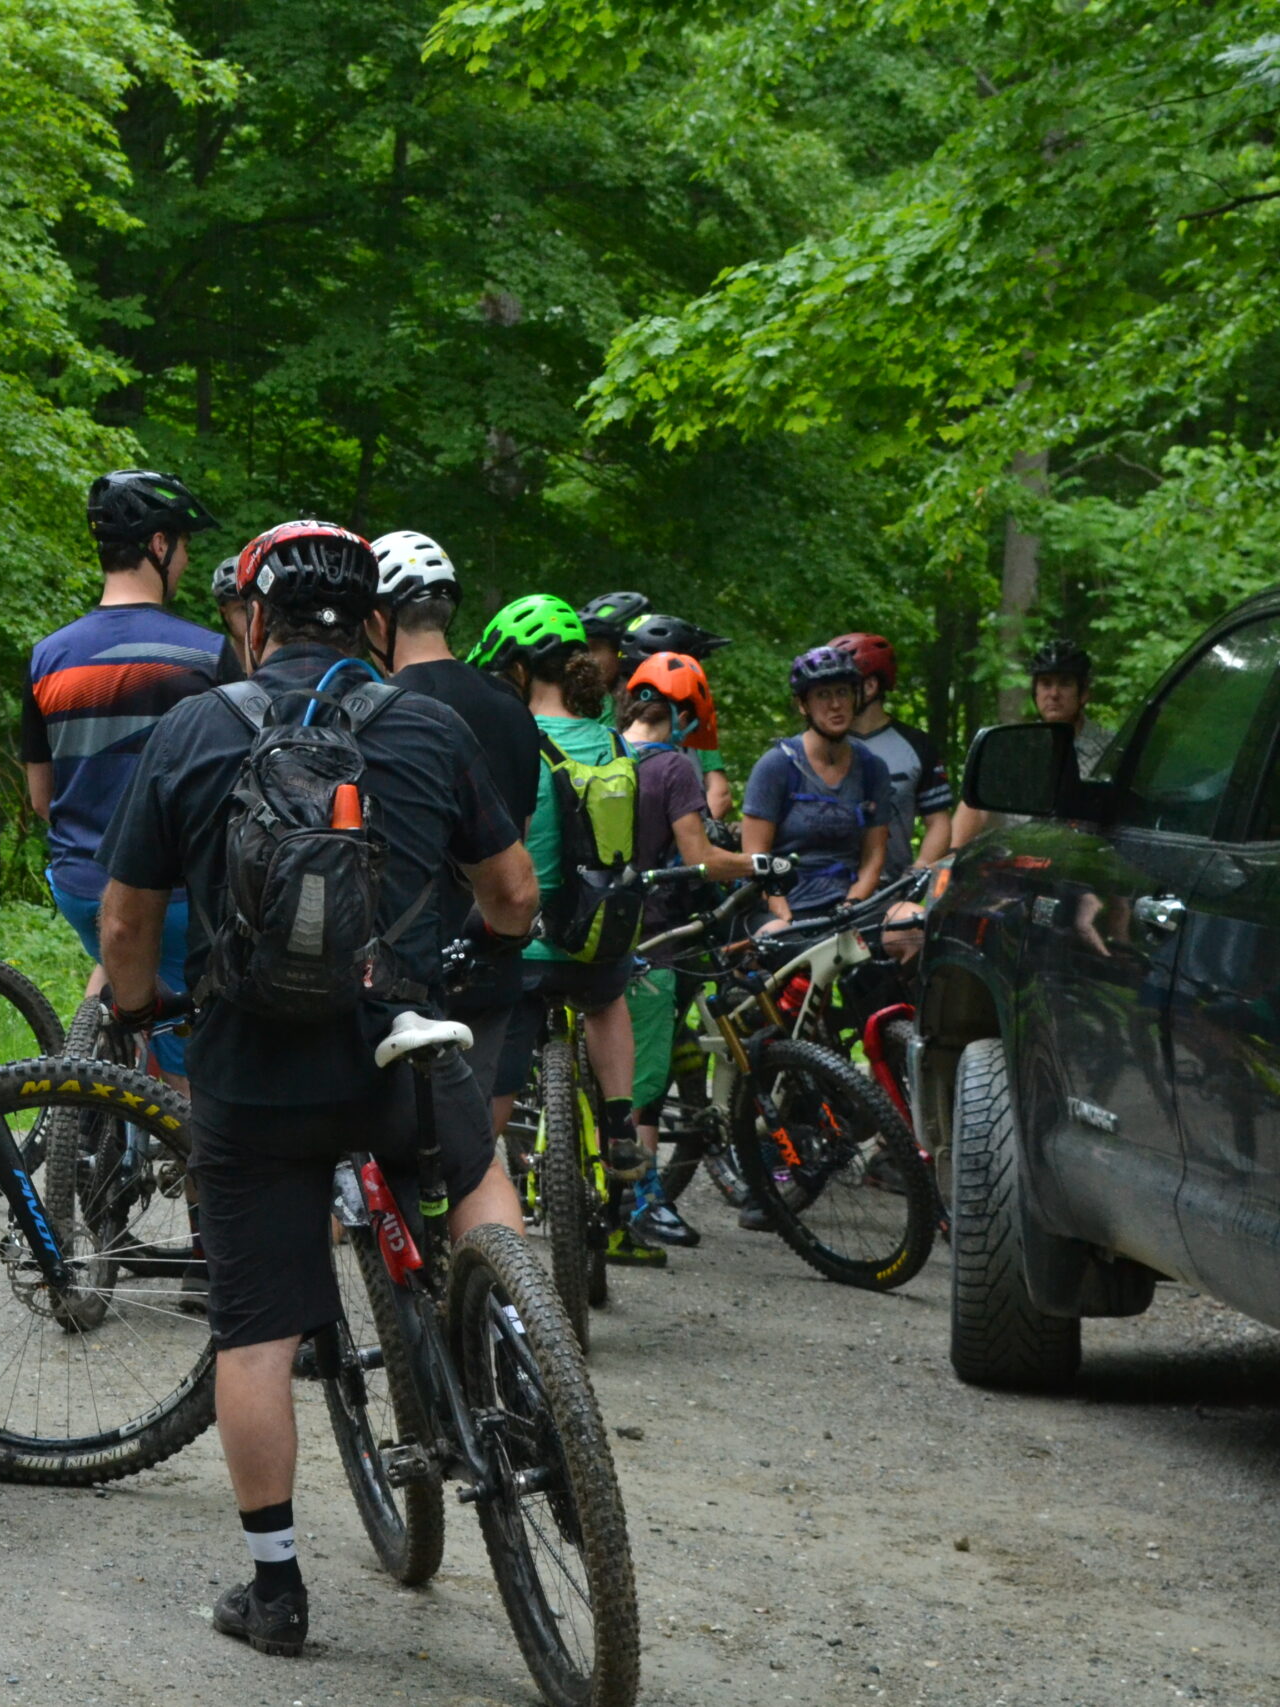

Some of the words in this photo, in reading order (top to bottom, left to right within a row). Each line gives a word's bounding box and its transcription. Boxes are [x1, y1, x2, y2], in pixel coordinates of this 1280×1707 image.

[20, 1079, 182, 1130] MAXXIS
[771, 1127, 801, 1167] FOX
[12, 1168, 61, 1260] PIVOT
